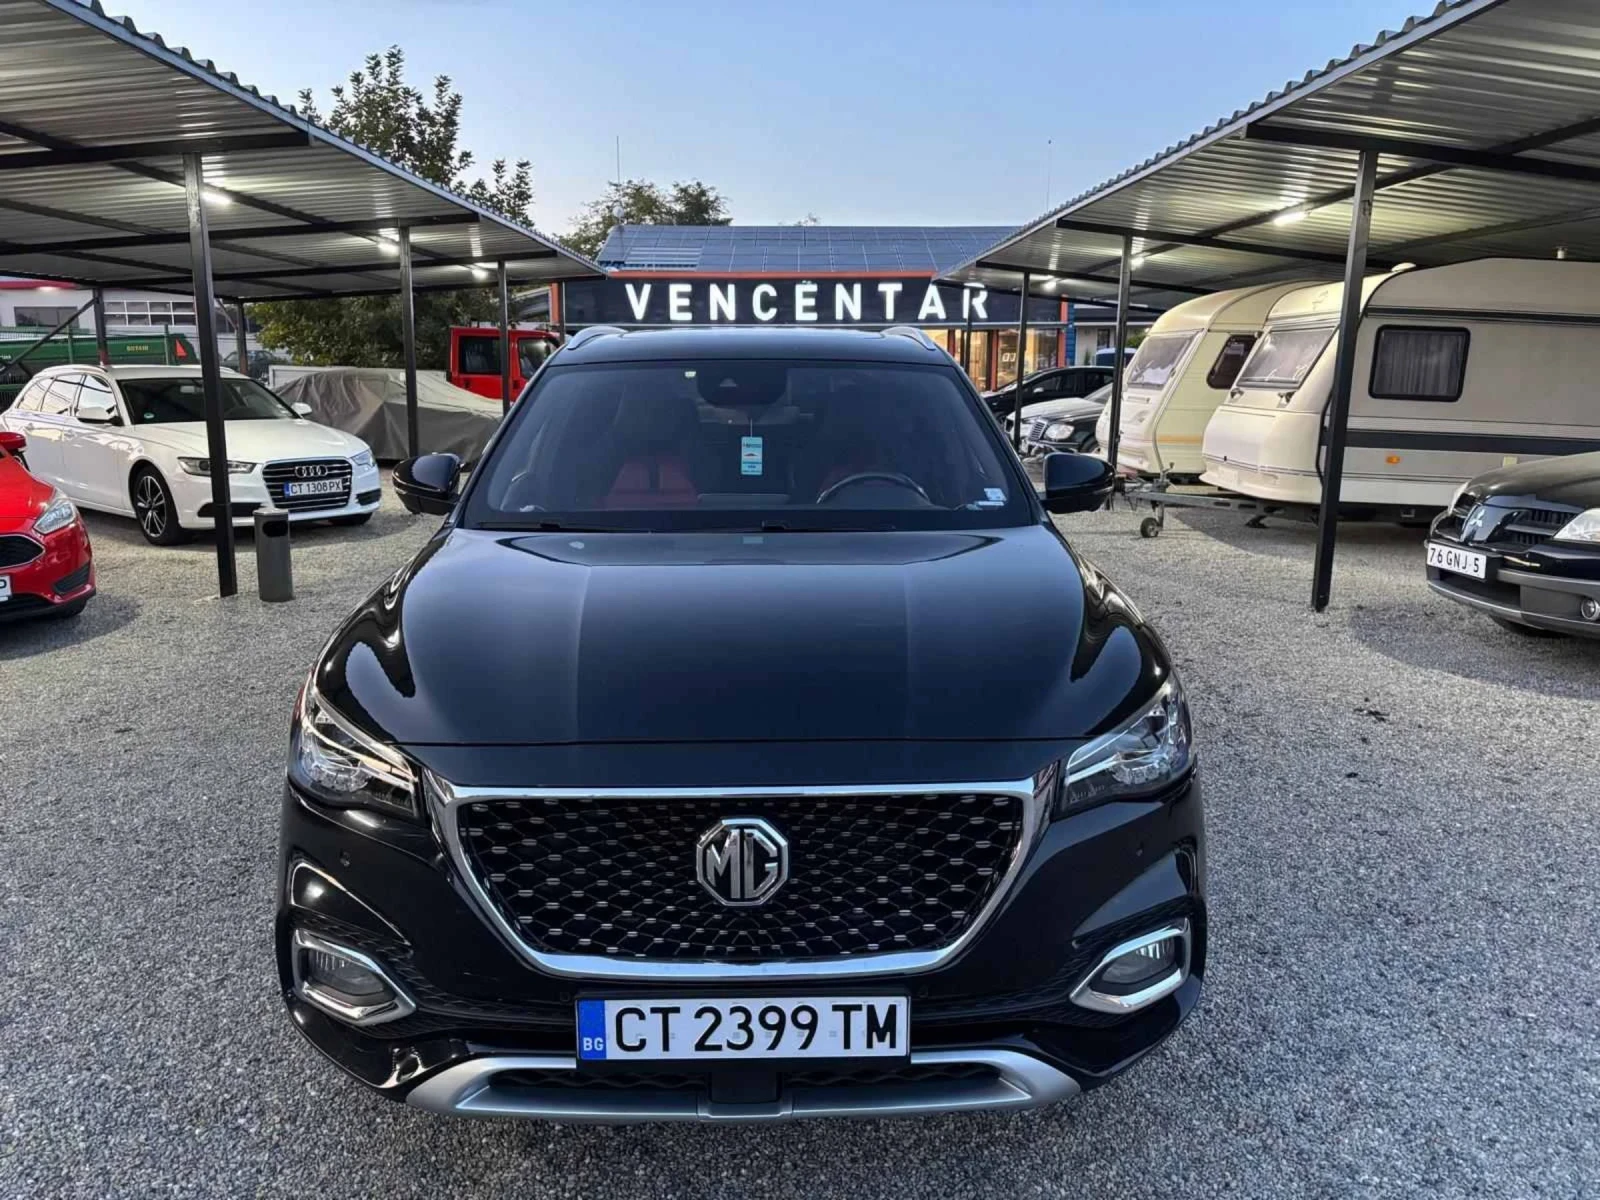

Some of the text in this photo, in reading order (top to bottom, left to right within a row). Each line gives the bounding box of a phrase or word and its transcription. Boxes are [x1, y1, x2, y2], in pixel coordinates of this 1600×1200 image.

[290, 480, 341, 494] CT 1308 PX
[705, 828, 779, 899] MG
[582, 1037, 604, 1051] BG
[615, 1003, 897, 1053] CT 2399 TM
